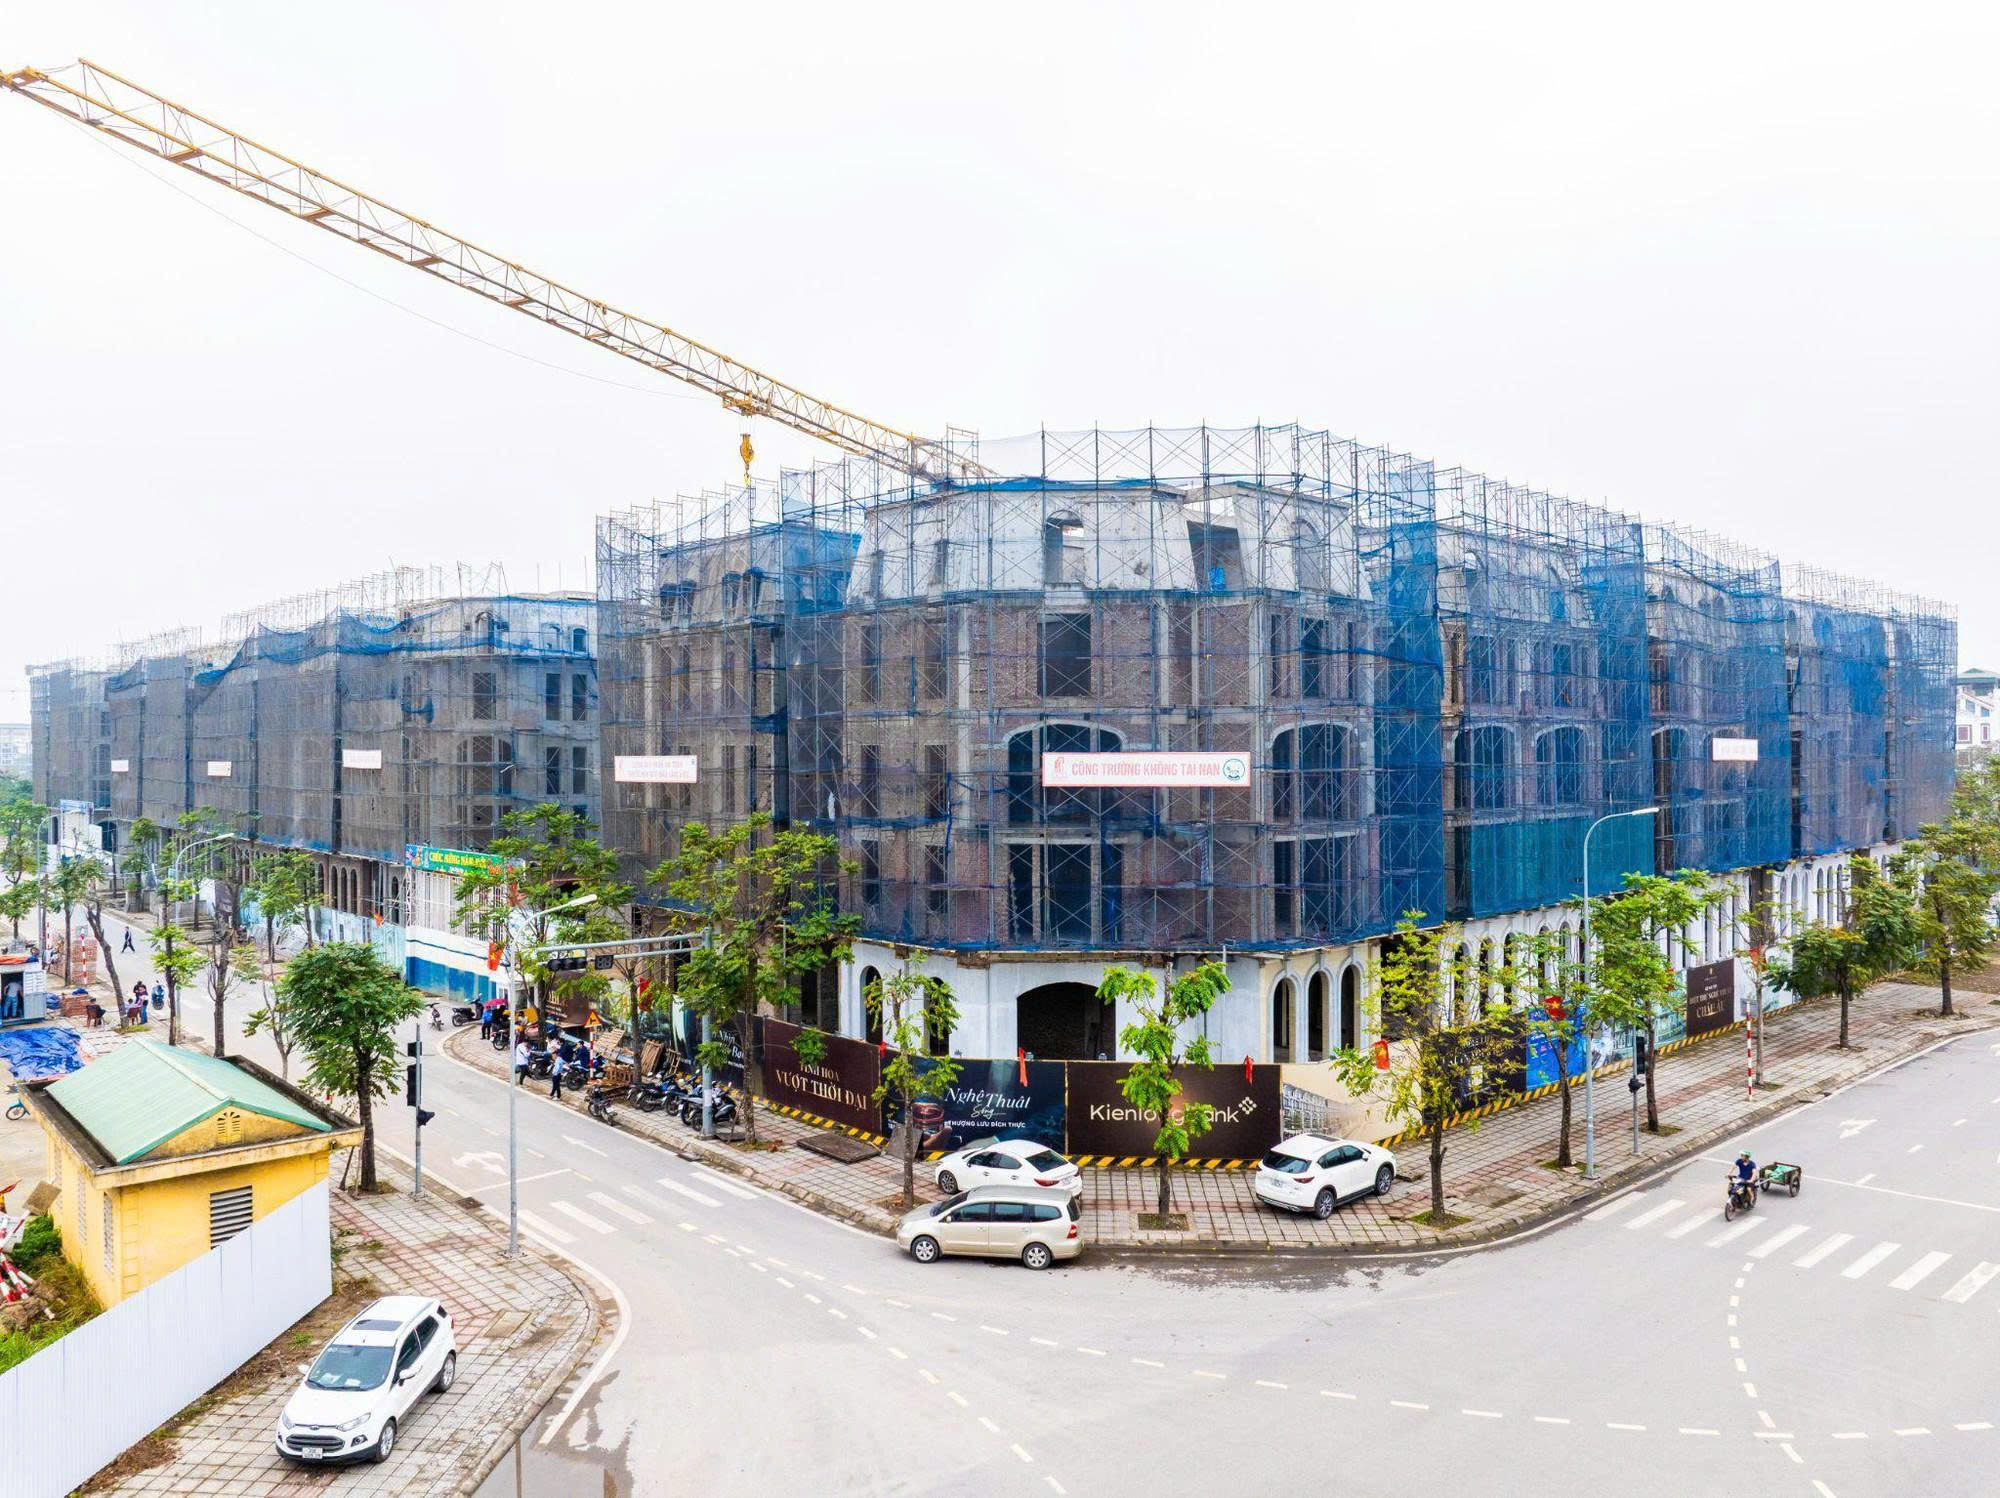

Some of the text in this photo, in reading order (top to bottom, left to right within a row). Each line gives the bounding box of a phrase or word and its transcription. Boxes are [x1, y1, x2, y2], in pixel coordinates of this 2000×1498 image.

[1071, 760, 1098, 776] CÔNG
[1101, 760, 1141, 776] TRƯỜNG
[1143, 760, 1178, 776] KHÔNG
[1180, 763, 1197, 776] TAI
[776, 1069, 867, 1111] VƯỢT THỜI ĐẠI
[1090, 1103, 1240, 1126] Kienlogank
